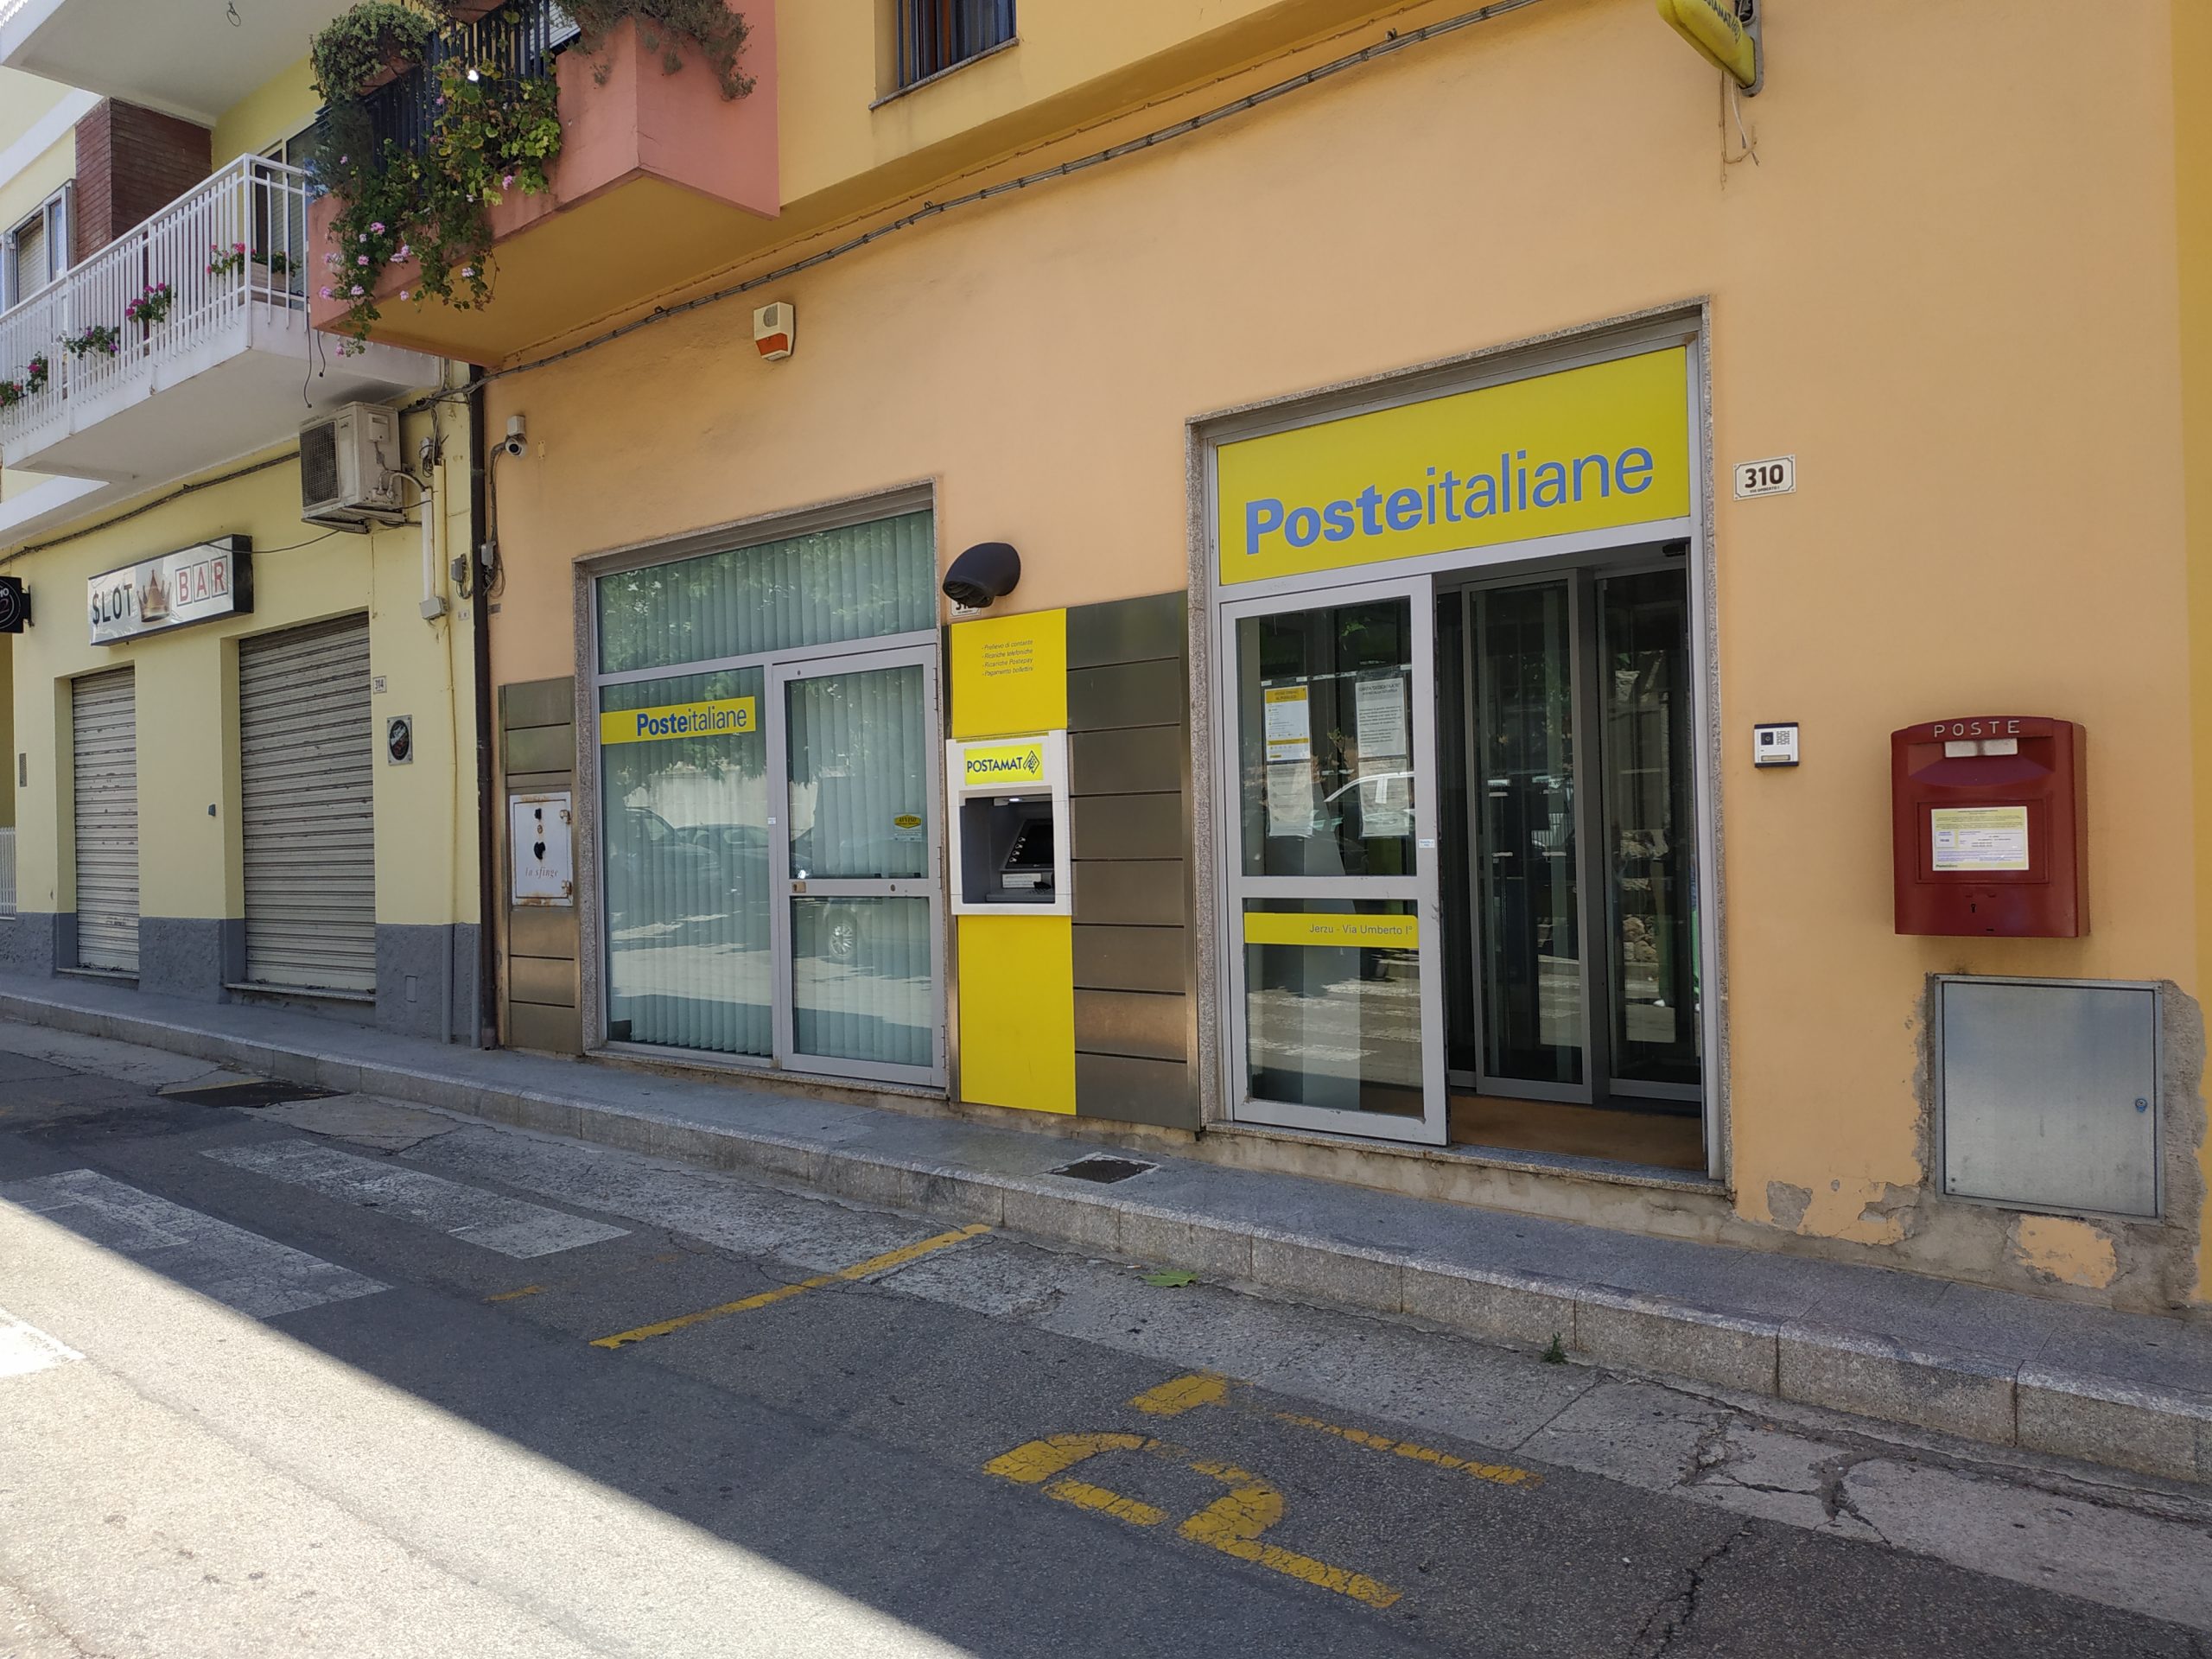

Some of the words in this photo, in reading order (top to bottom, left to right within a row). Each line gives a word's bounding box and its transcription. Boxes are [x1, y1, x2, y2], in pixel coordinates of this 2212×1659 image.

[1745, 464, 1783, 488] 310
[1246, 447, 1654, 555] Posteitaliane
[179, 561, 225, 602] BAR
[636, 706, 747, 736] Posteitaliane
[1934, 720, 2020, 738] POSTE
[967, 757, 1023, 772] POSTAMAT
[536, 866, 559, 879] sfinge
[1310, 924, 1333, 933] Jerzu
[1343, 924, 1357, 934] Via
[1360, 925, 1402, 935] Umberto
